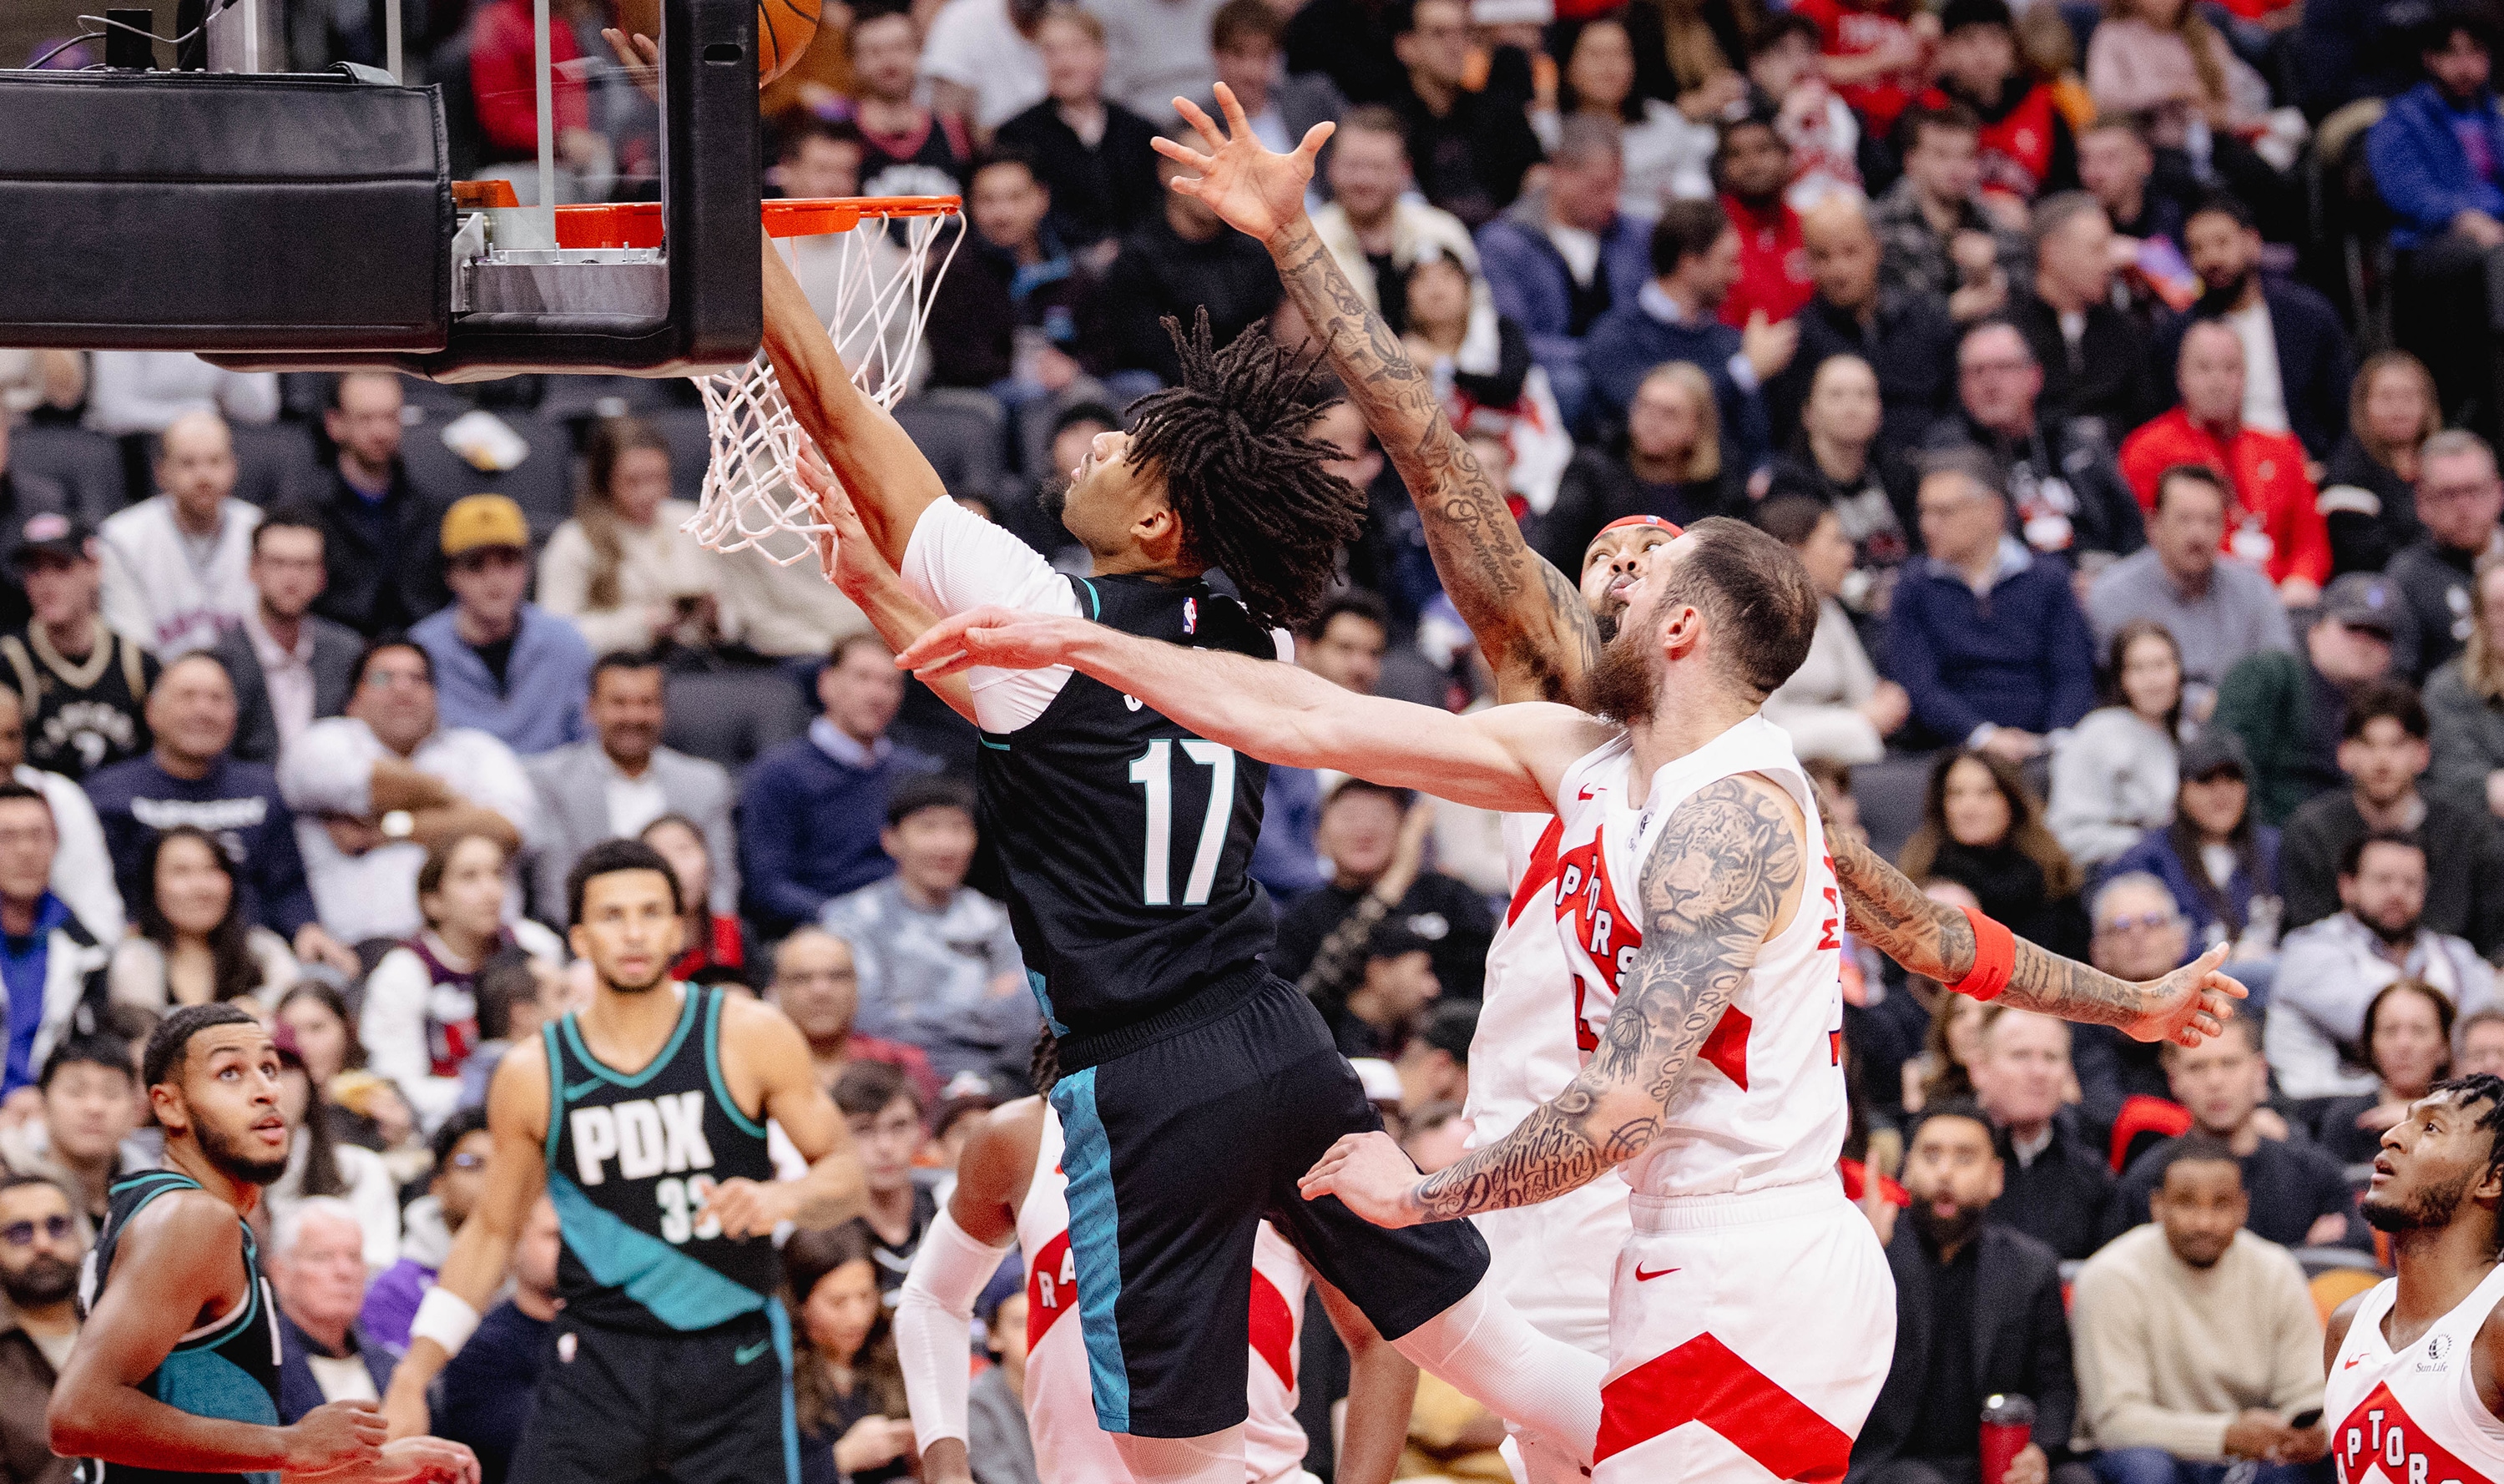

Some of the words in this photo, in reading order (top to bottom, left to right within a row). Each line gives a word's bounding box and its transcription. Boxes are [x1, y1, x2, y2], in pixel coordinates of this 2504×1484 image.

[1129, 739, 1235, 905] 17
[569, 1089, 715, 1186] PDX
[1441, 1118, 1569, 1213] Defines
[1492, 1139, 1598, 1209] Destiny
[2416, 1362, 2431, 1373] Sun
[2432, 1361, 2448, 1373] Life
[2337, 1409, 2465, 1484] APTOR
